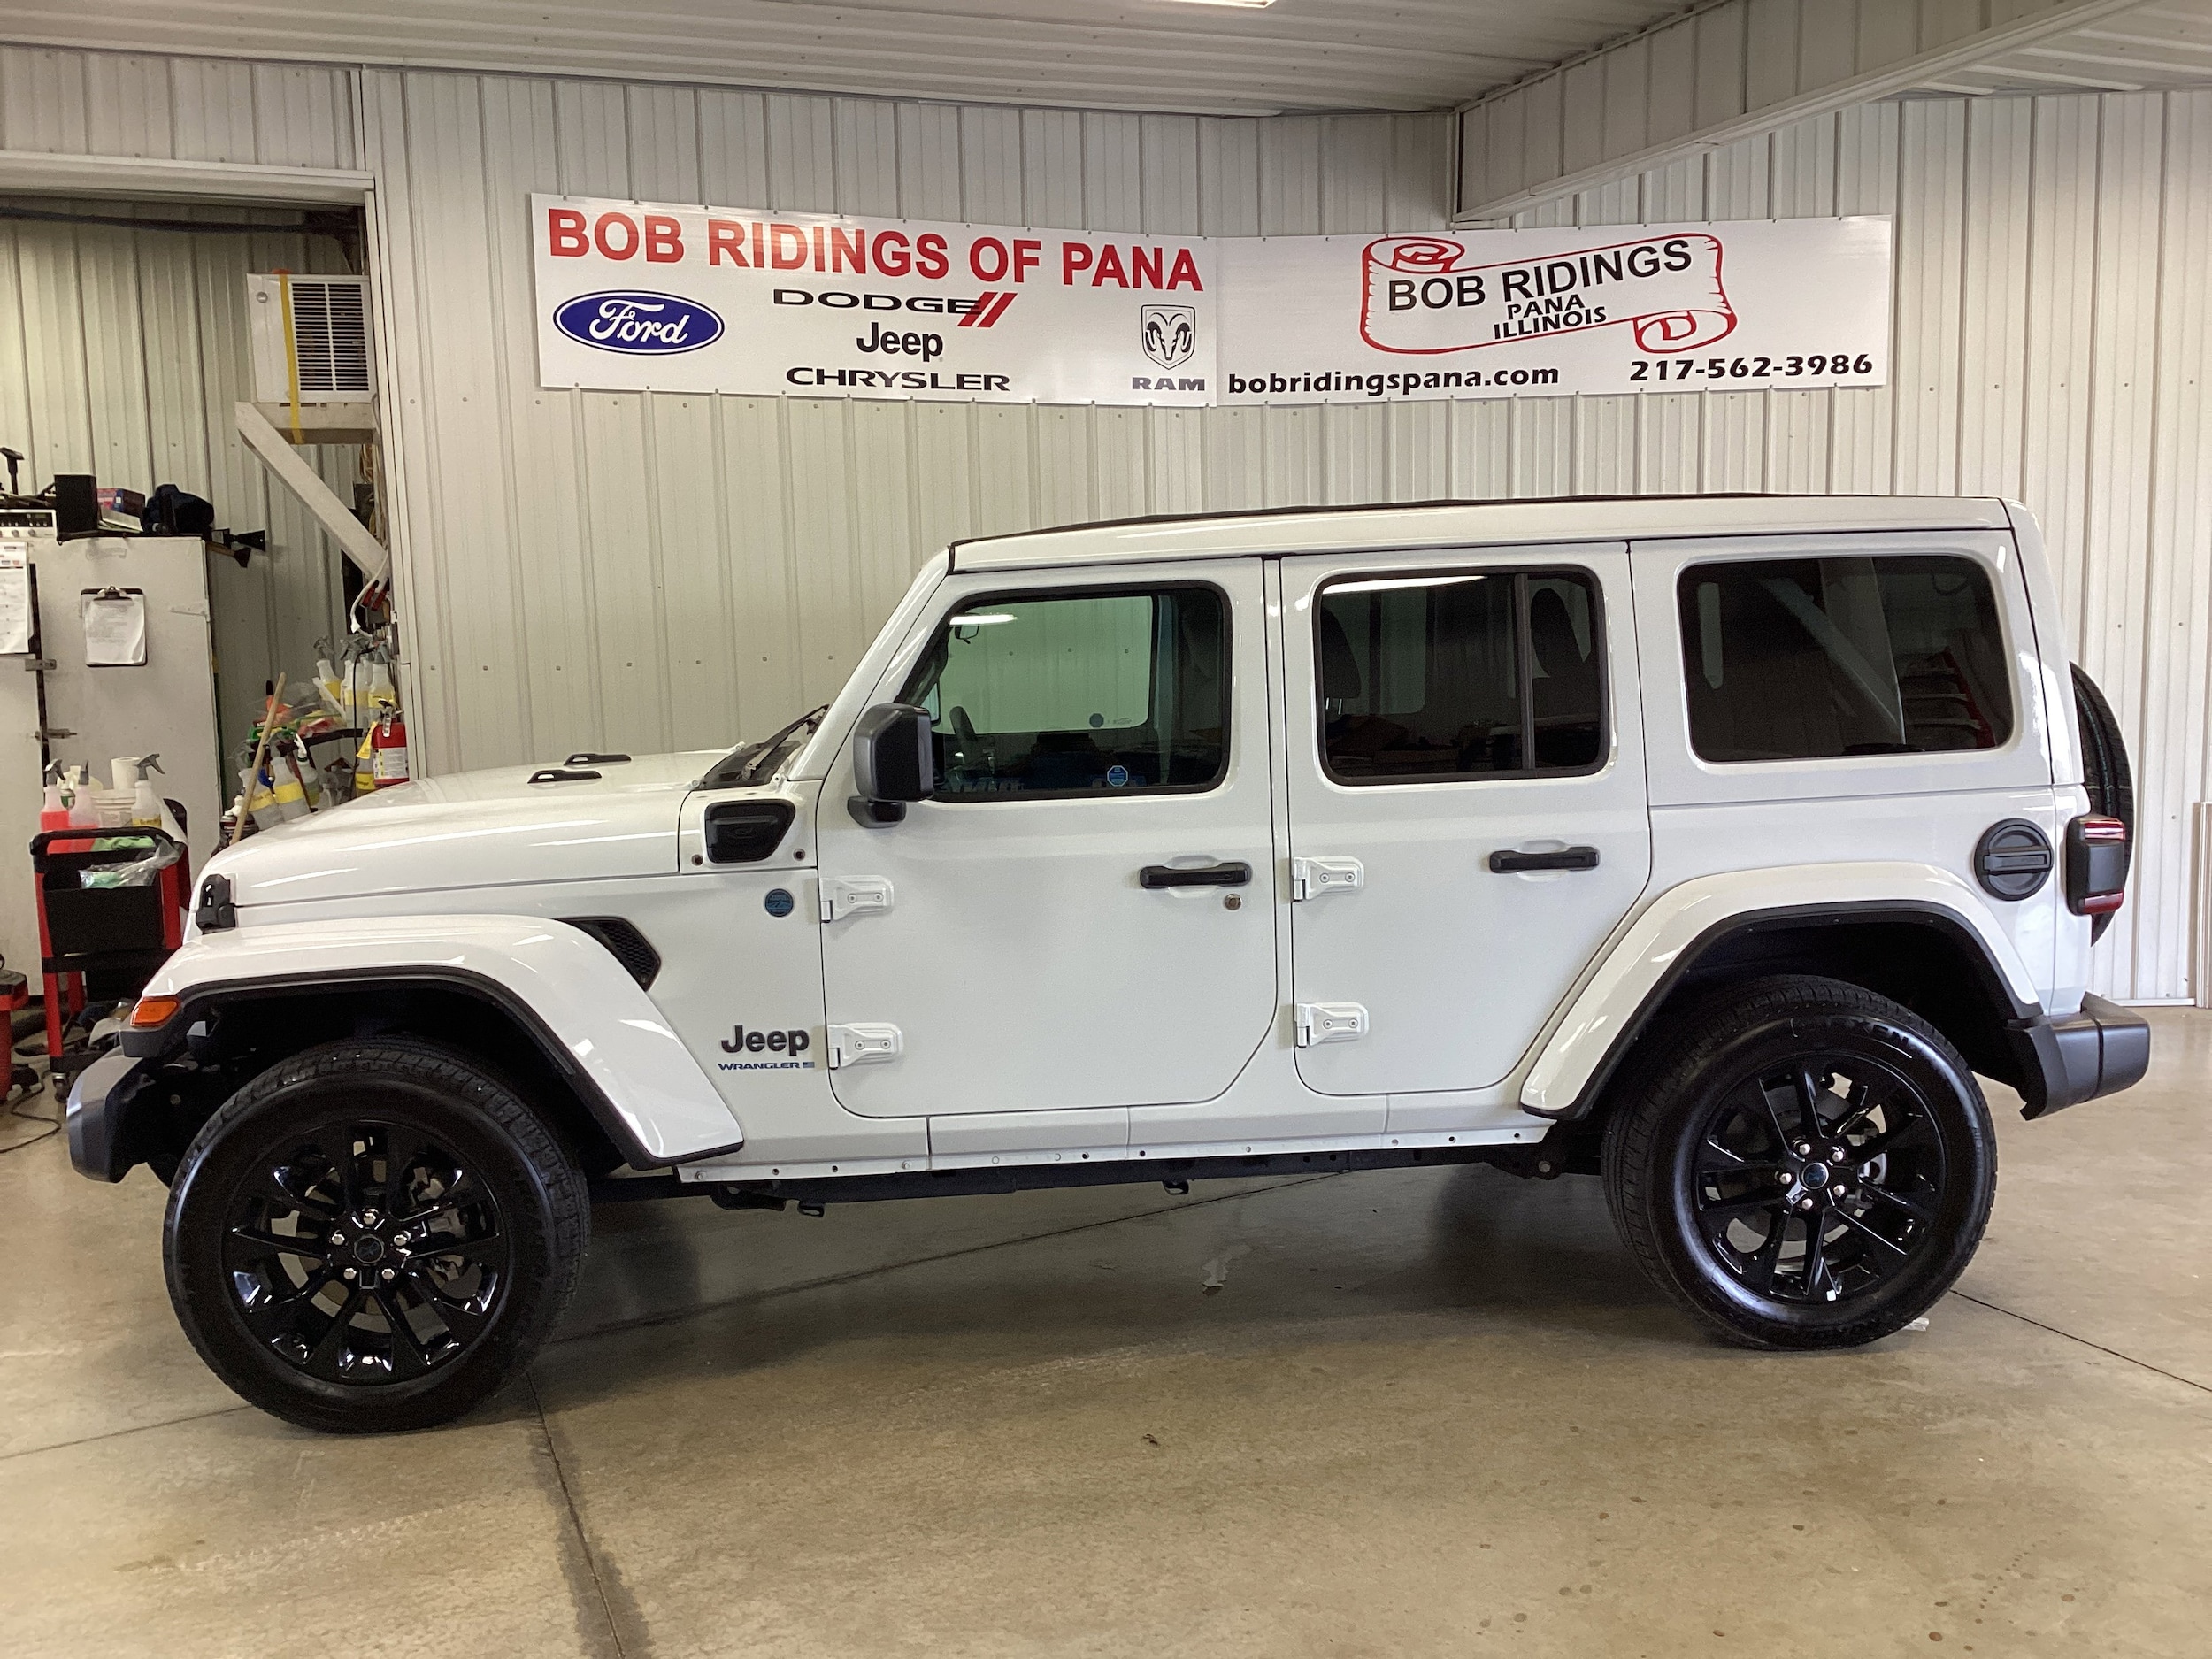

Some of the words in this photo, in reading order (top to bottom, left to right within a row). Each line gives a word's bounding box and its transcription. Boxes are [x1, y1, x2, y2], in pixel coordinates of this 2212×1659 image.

[548, 208, 685, 265] BOB
[708, 219, 950, 280] RIDINGS
[969, 236, 1042, 284] OF
[1062, 242, 1204, 292] PANA
[1388, 275, 1486, 311] BOB
[1502, 239, 1693, 303] RIDINGS
[773, 288, 983, 315] DODGE
[1507, 294, 1586, 321] PANA
[588, 298, 691, 344] Ford
[1494, 306, 1608, 340] ILLINOIS
[856, 321, 944, 363] Jeep
[786, 367, 1011, 391] CHRYSLER
[1630, 353, 1874, 381] 217-562-3986
[1132, 377, 1206, 391] RAM
[1228, 368, 1559, 396] bobridingspana.com
[720, 1024, 810, 1057] Jeep
[718, 1061, 801, 1071] WRANGLER
